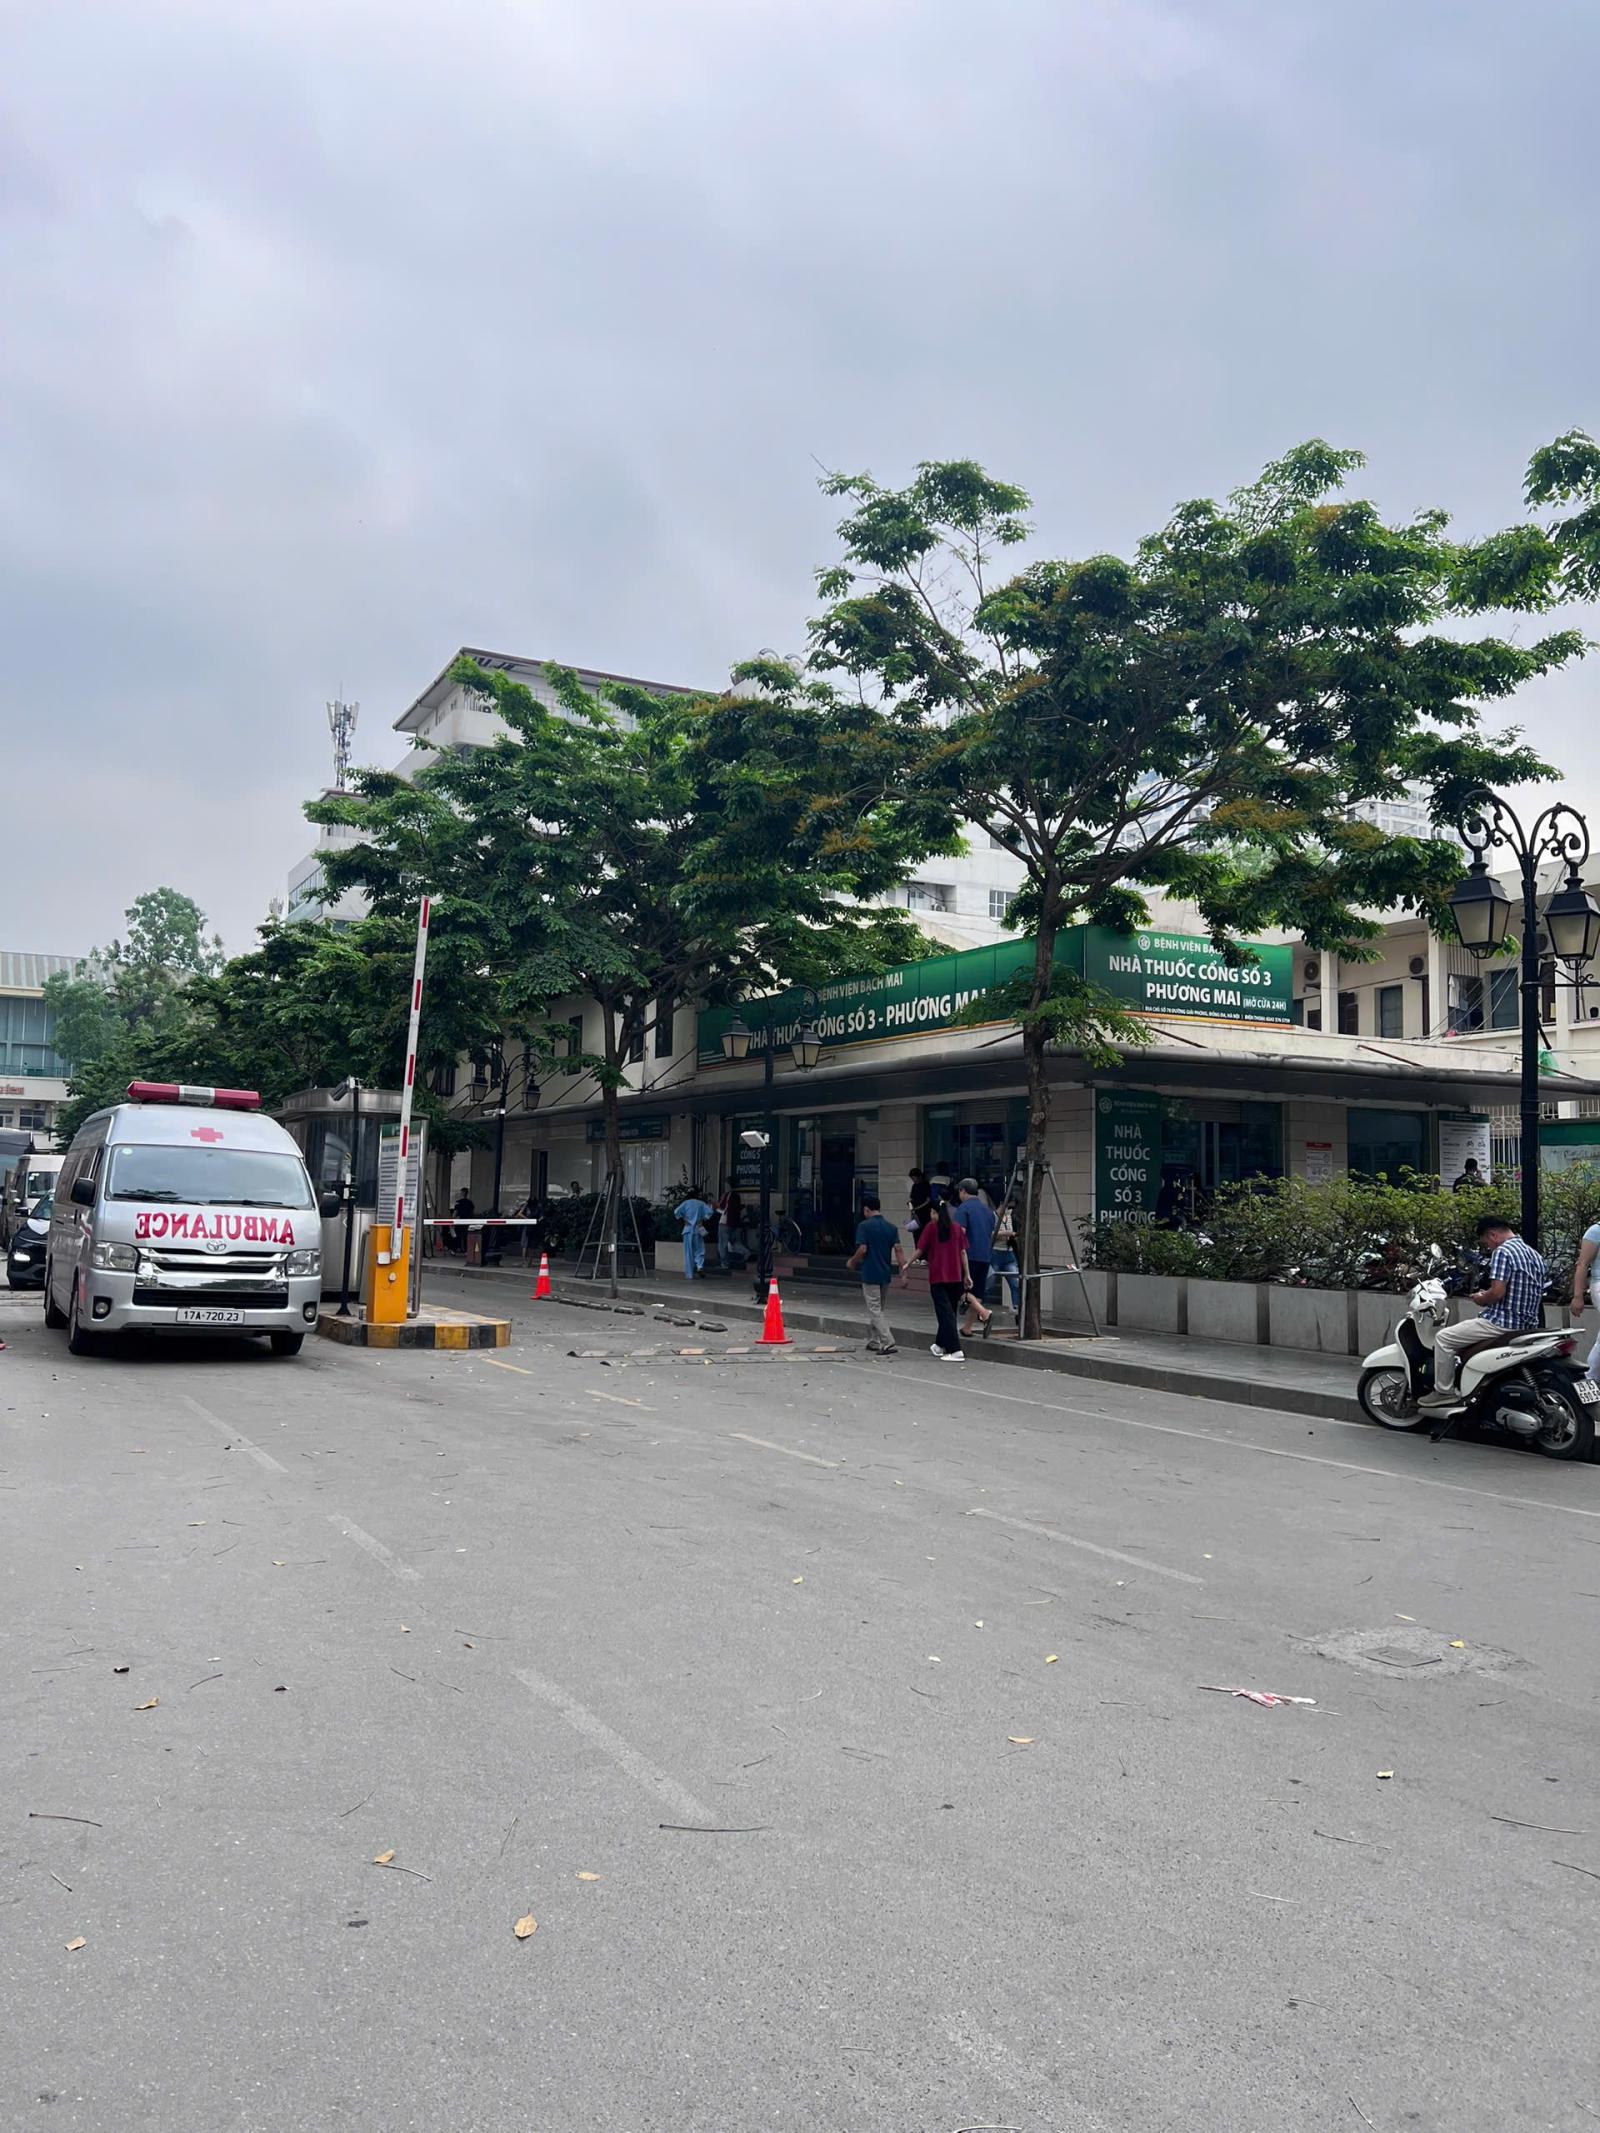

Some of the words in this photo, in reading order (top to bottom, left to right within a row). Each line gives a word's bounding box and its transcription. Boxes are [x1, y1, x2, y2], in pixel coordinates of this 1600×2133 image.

[1154, 937, 1179, 951] BỆNH
[1180, 940, 1201, 954] VIỆN
[1109, 954, 1142, 974] NHÀ
[1144, 957, 1195, 979] THUỐC
[1198, 961, 1239, 983] CỔNG
[1242, 965, 1260, 985] SỐ
[1263, 971, 1272, 986] 3
[839, 984, 859, 999] VIỆN
[859, 978, 884, 996] BẠCH
[885, 972, 903, 988] MAI
[1146, 982, 1211, 1003] PHƯƠNG
[1214, 990, 1241, 1006] MAI
[1243, 997, 1257, 1009] (MỞ
[1257, 997, 1271, 1010] CỬA
[1272, 1000, 1287, 1012] 24H)
[847, 1004, 866, 1031] SỐ
[868, 1013, 876, 1030] 3
[886, 994, 951, 1027] PHƯƠNG
[1114, 1123, 1142, 1139] NHÀ
[1105, 1143, 1151, 1160] THUỐC
[1110, 1163, 1147, 1181] CỔNG
[1114, 1184, 1132, 1202] SỐ
[1135, 1190, 1142, 1203] 3
[184, 1311, 239, 1322] 17A-720.23
